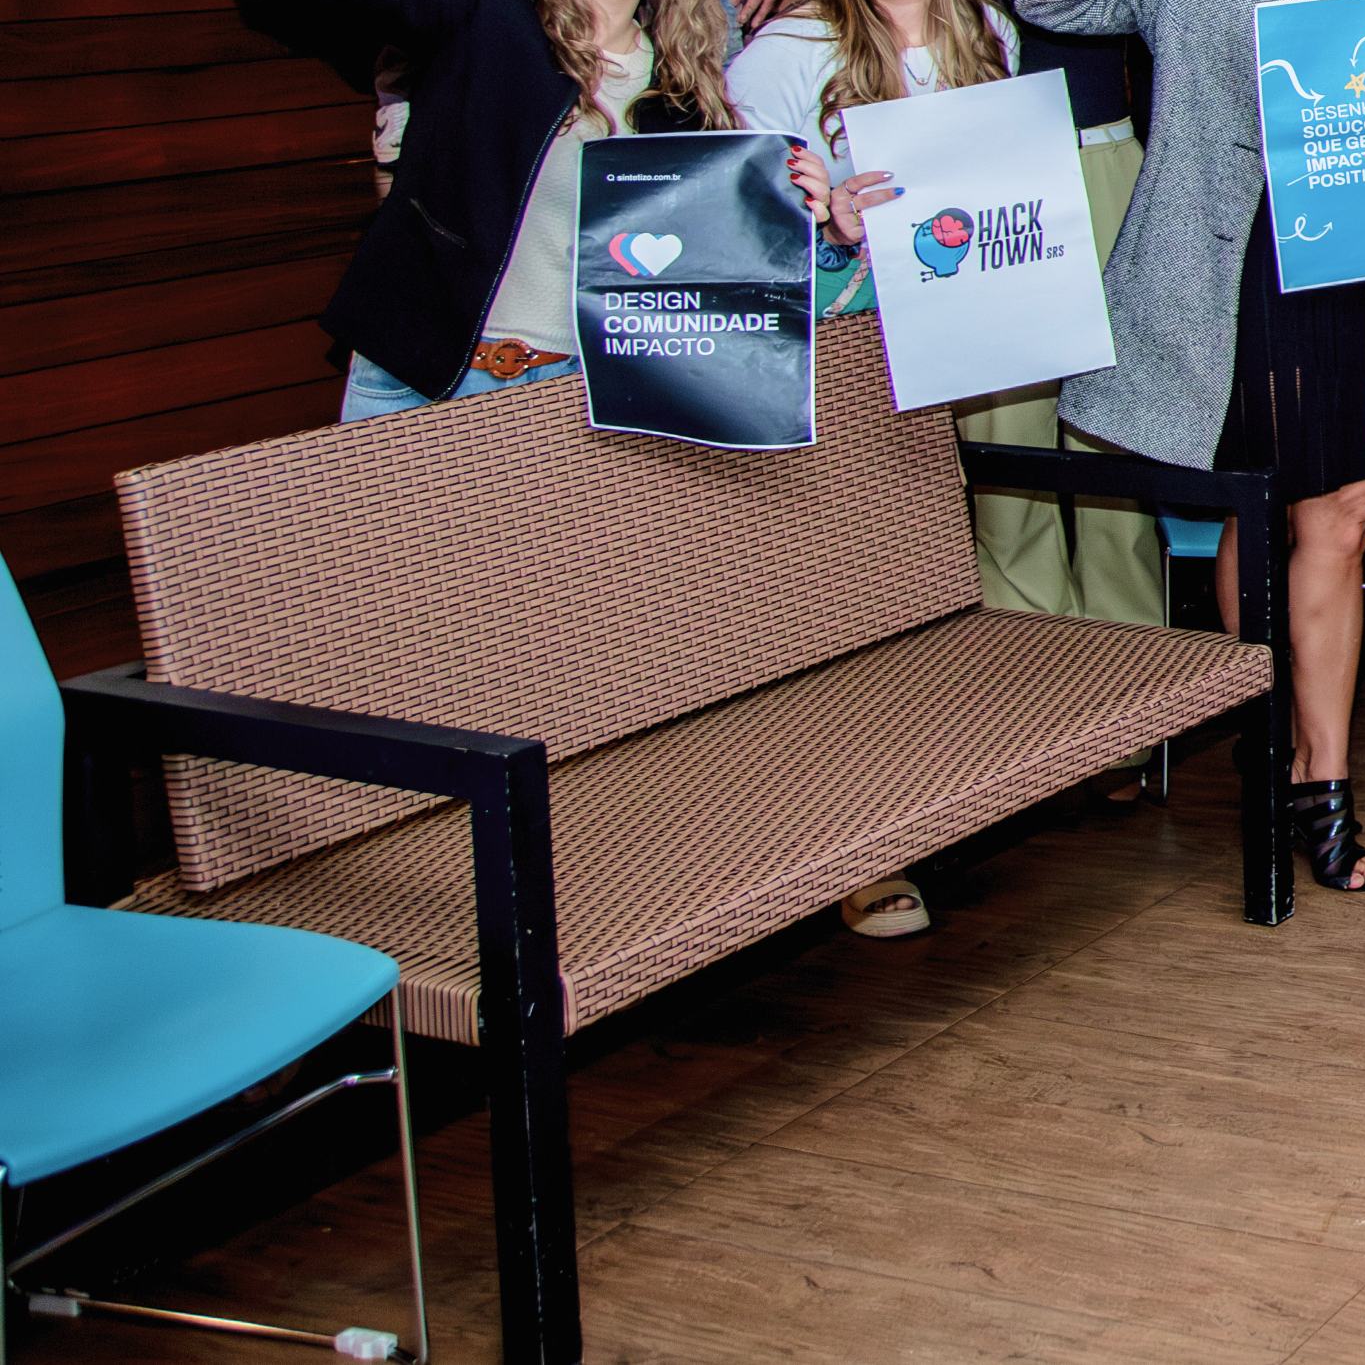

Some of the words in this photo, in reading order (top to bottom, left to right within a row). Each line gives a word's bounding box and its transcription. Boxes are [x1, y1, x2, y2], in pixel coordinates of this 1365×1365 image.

[1304, 138, 1342, 157] QUE
[617, 173, 681, 181] sintetizo.com.br
[978, 199, 1043, 242] HACK
[978, 232, 1043, 271] TOWN
[1046, 245, 1065, 259] SRS
[605, 291, 701, 311] DESIGN
[604, 313, 780, 333] COMUNIDADE
[605, 337, 716, 356] IMPACTO
